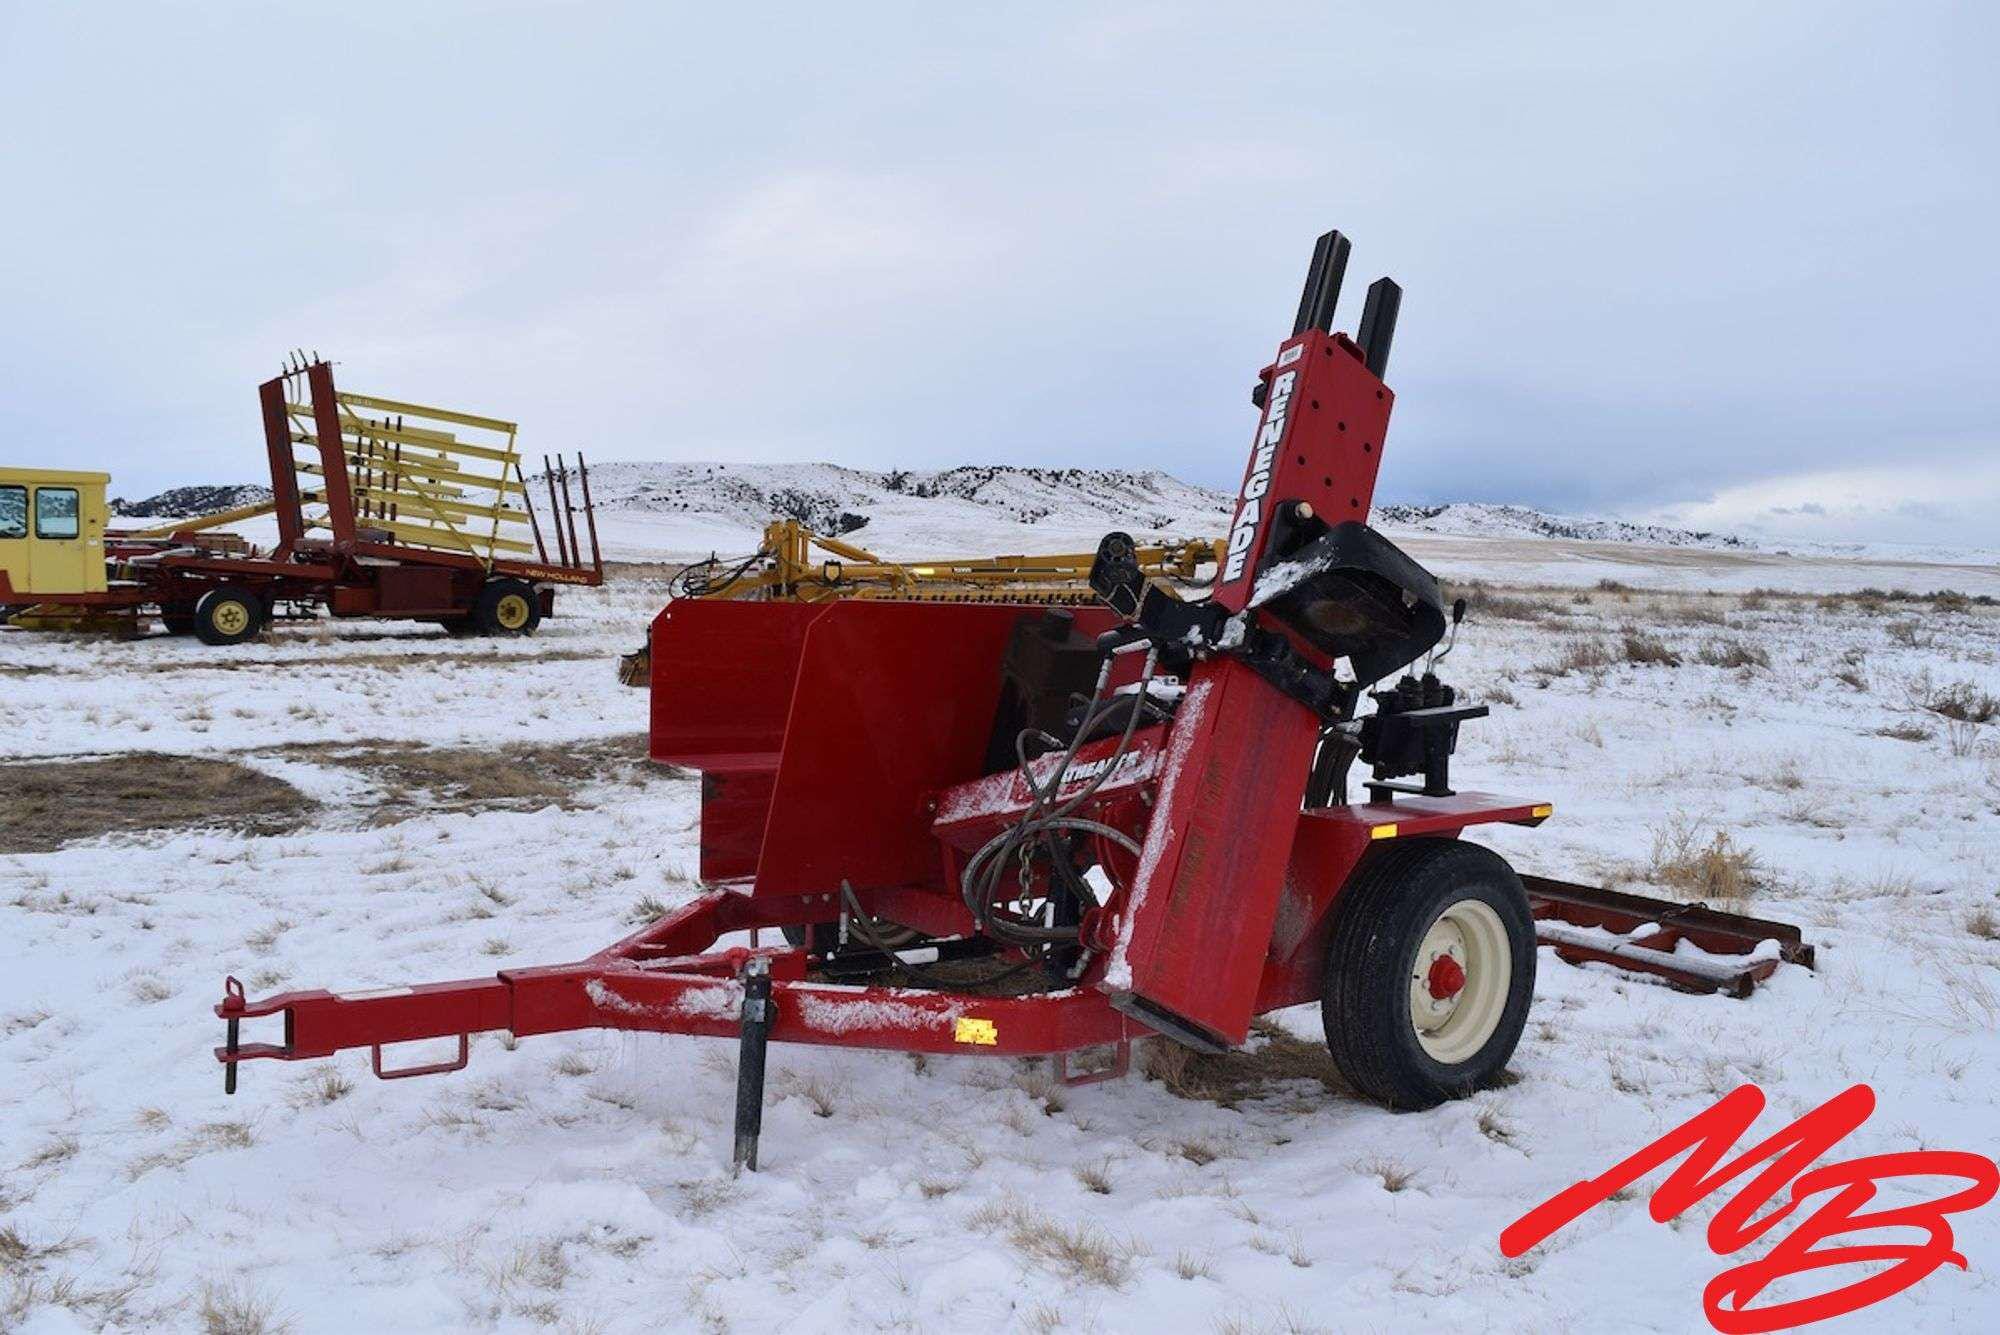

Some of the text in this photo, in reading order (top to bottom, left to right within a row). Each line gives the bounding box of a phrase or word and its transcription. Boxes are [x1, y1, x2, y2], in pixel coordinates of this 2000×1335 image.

[1222, 370, 1297, 583] RENEGADE
[526, 568, 588, 584] NEW HOLLAND
